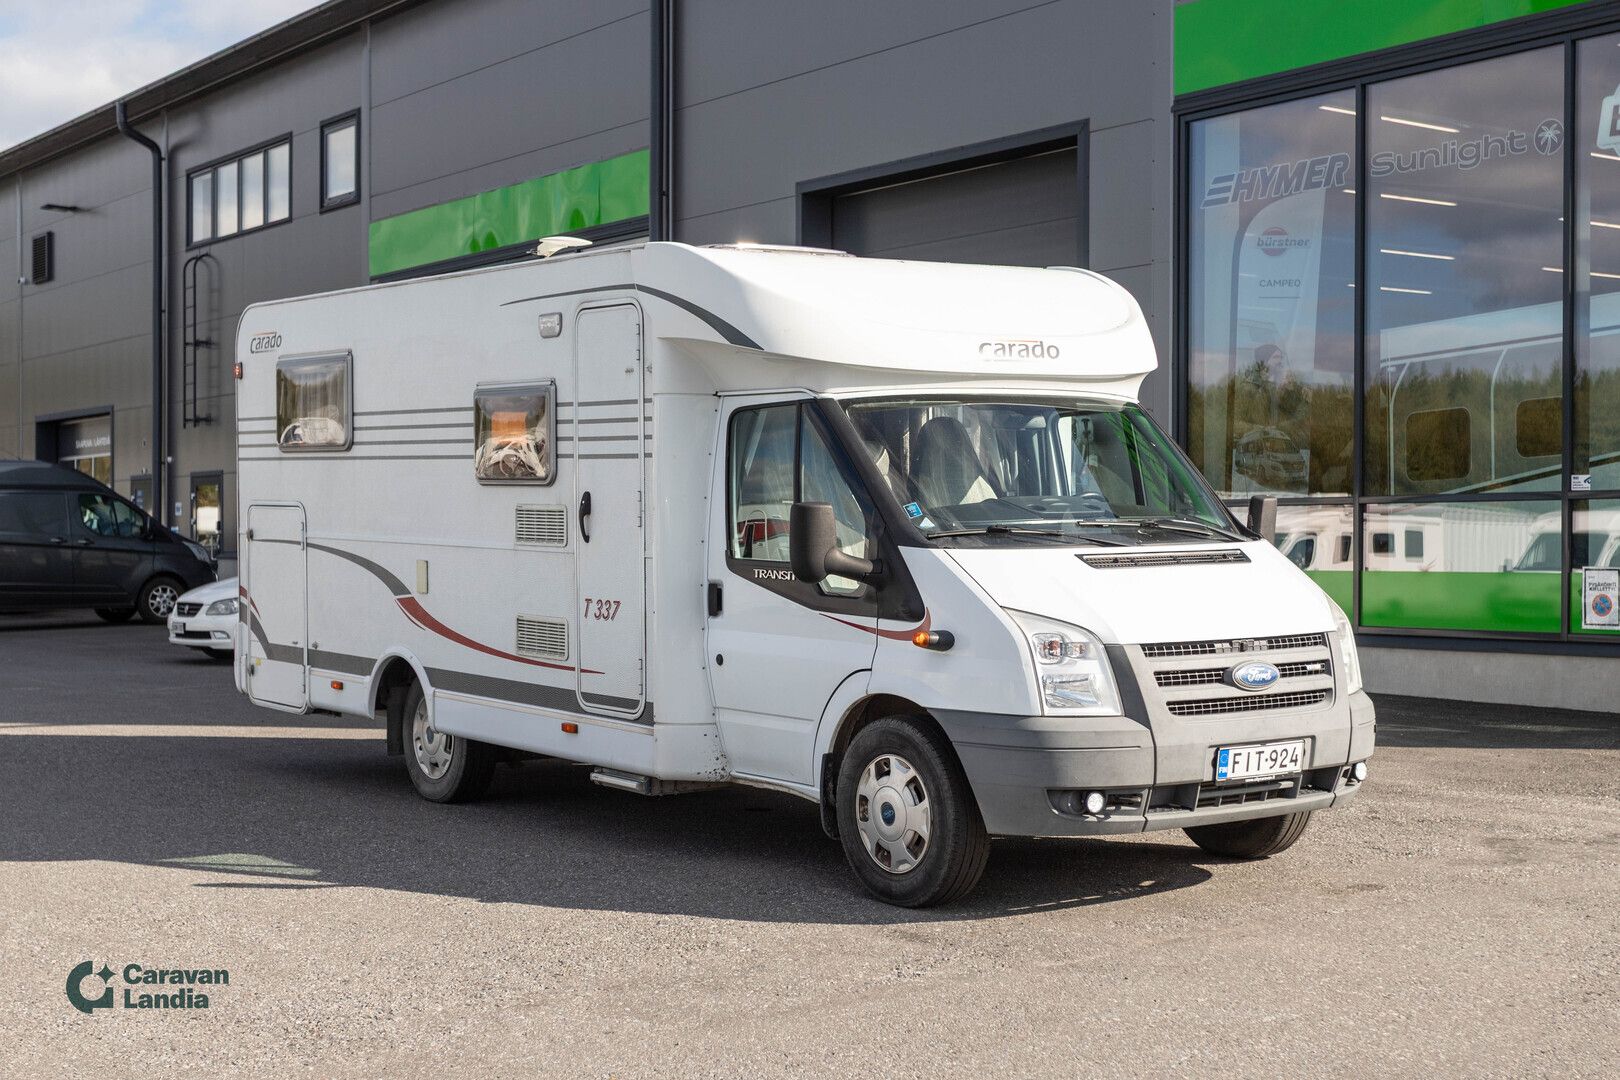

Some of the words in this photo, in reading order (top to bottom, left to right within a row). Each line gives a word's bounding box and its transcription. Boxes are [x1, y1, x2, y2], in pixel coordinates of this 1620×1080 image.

[1371, 130, 1527, 177] Sunlight
[1229, 152, 1351, 203] HYMER
[1257, 237, 1310, 247] bürstner
[1259, 279, 1301, 288] CAMPEO
[250, 331, 282, 354] carado
[978, 340, 1060, 360] carado
[584, 598, 592, 619] T
[594, 599, 621, 621] 337
[1247, 667, 1273, 683] Ford
